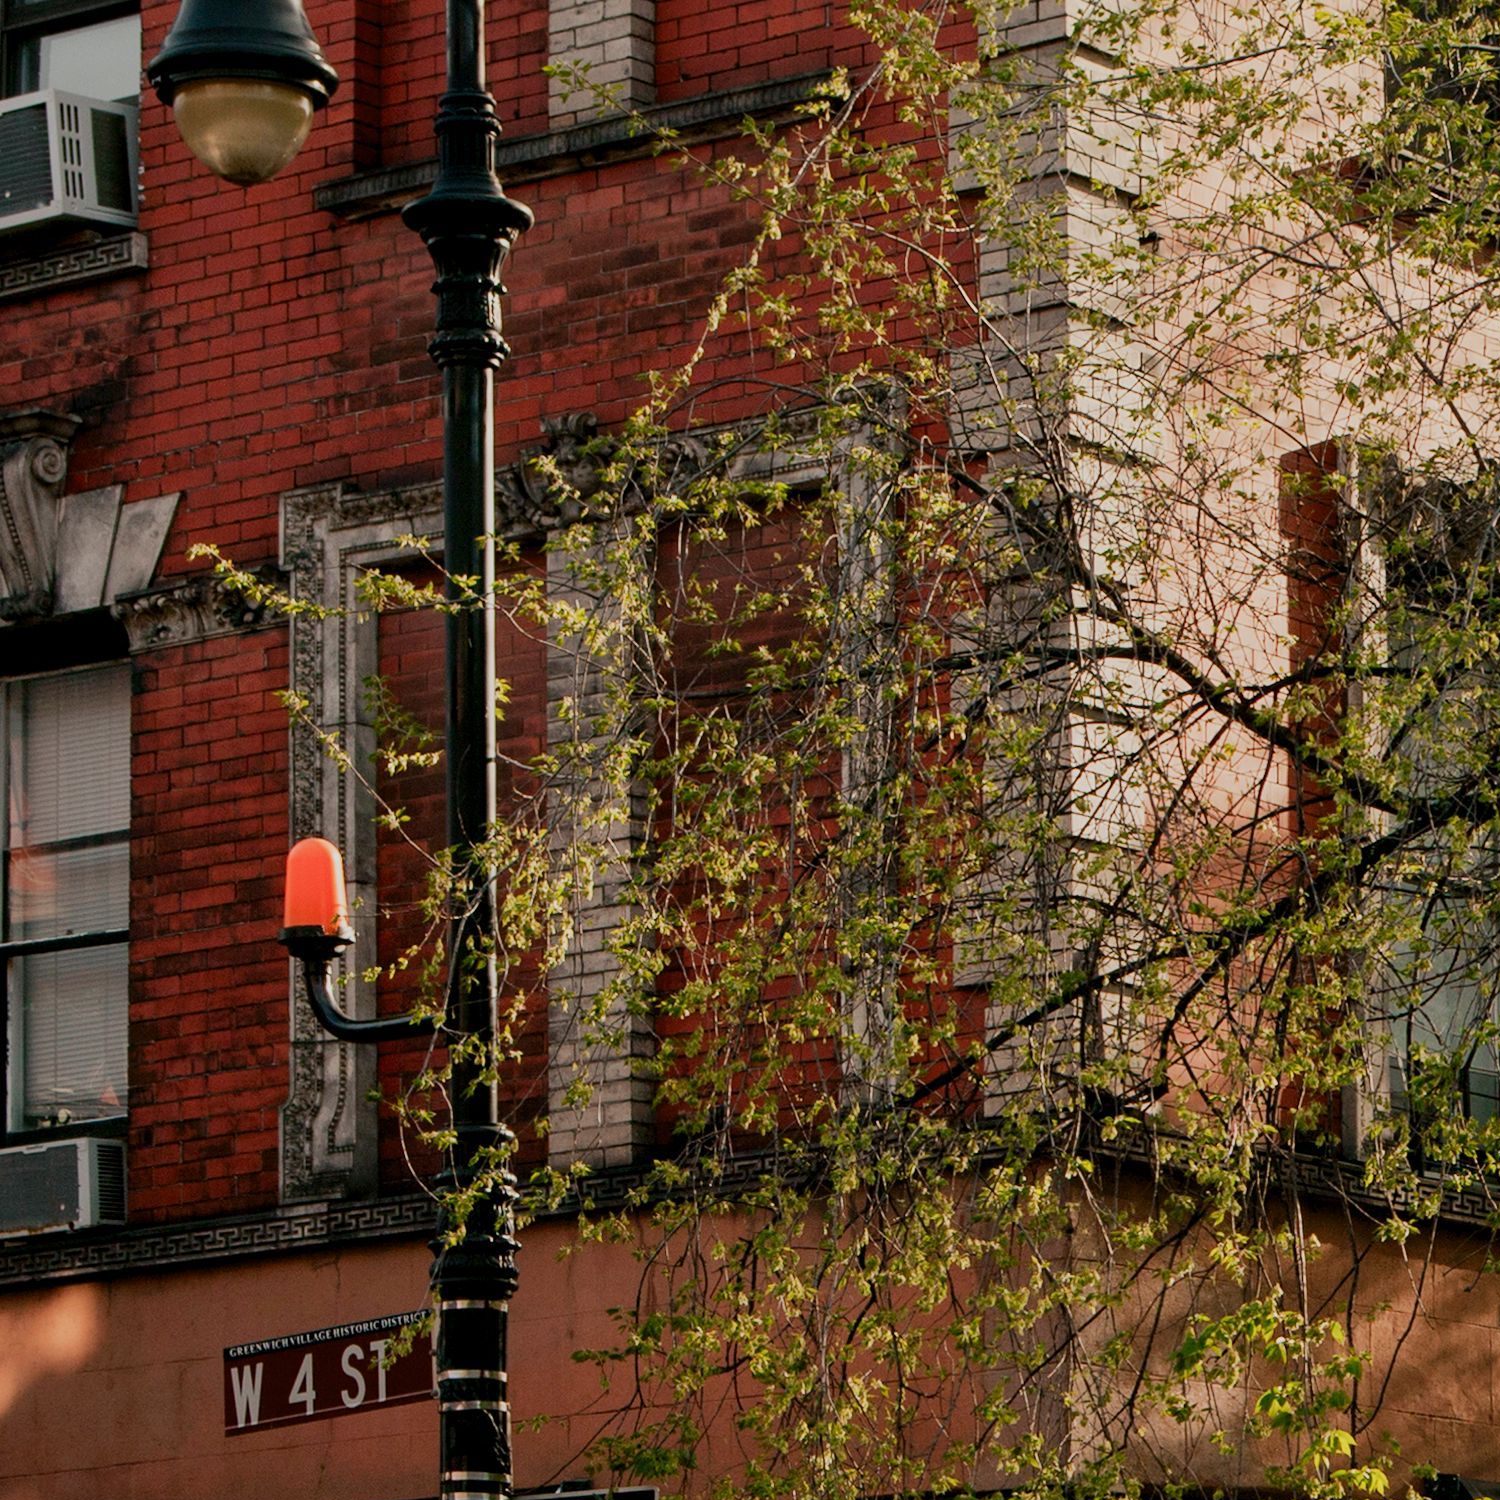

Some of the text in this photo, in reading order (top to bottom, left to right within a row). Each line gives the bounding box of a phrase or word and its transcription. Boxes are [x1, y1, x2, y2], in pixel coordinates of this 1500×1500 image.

[230, 1310, 427, 1358] GREENWICH VILLAGE HISTORIC DISTRICT
[230, 1338, 389, 1428] W 4 ST
